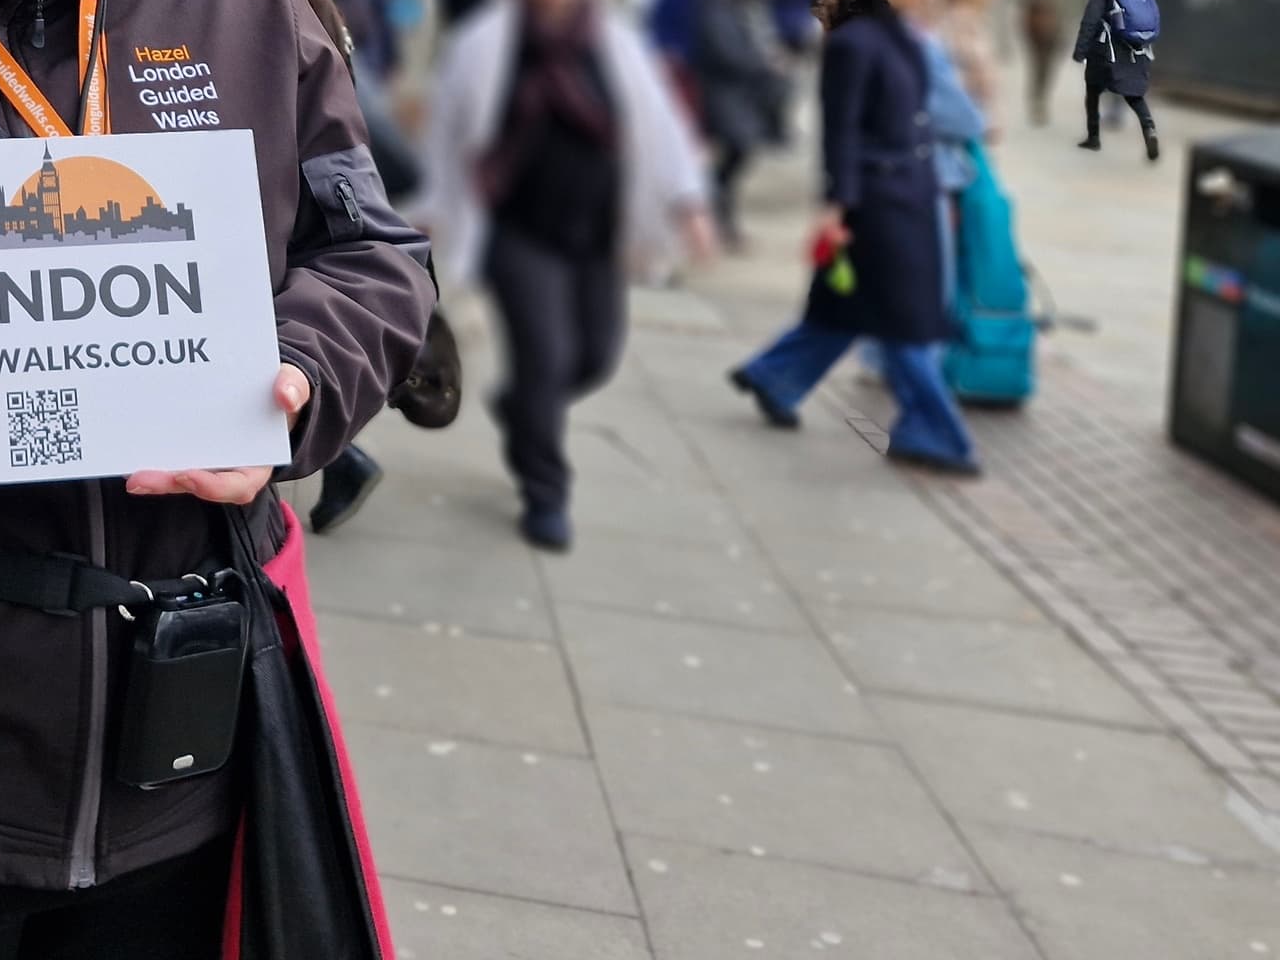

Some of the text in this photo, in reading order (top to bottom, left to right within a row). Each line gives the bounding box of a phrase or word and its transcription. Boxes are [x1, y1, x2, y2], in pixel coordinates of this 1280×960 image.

[135, 44, 191, 62] Hazel
[128, 62, 211, 83] London
[139, 81, 218, 106] Guided
[152, 108, 221, 130] Walks
